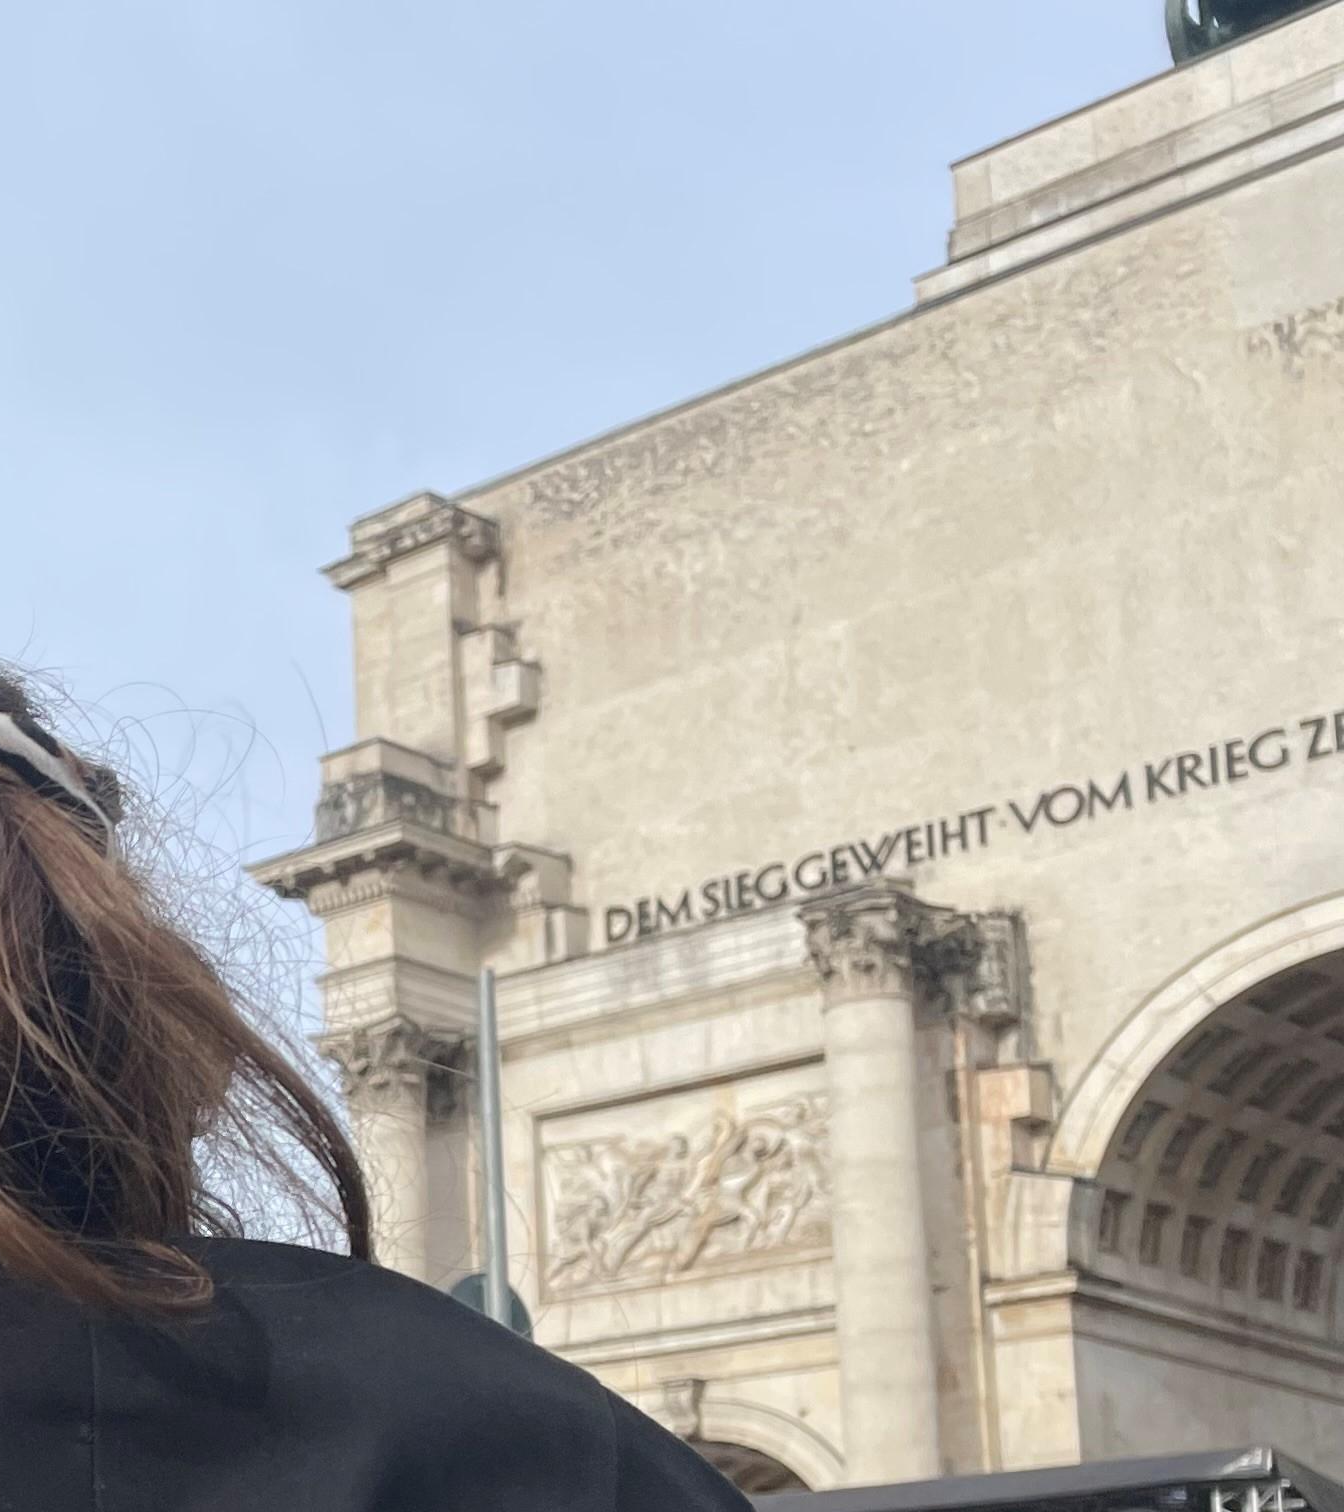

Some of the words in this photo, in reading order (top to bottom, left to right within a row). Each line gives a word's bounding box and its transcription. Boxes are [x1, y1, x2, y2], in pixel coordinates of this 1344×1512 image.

[605, 890, 692, 944] DEM
[700, 862, 790, 920] SIEG
[793, 805, 996, 889] GEWEIHT
[1008, 769, 1133, 834] VOM
[1143, 727, 1291, 804] KRIEG
